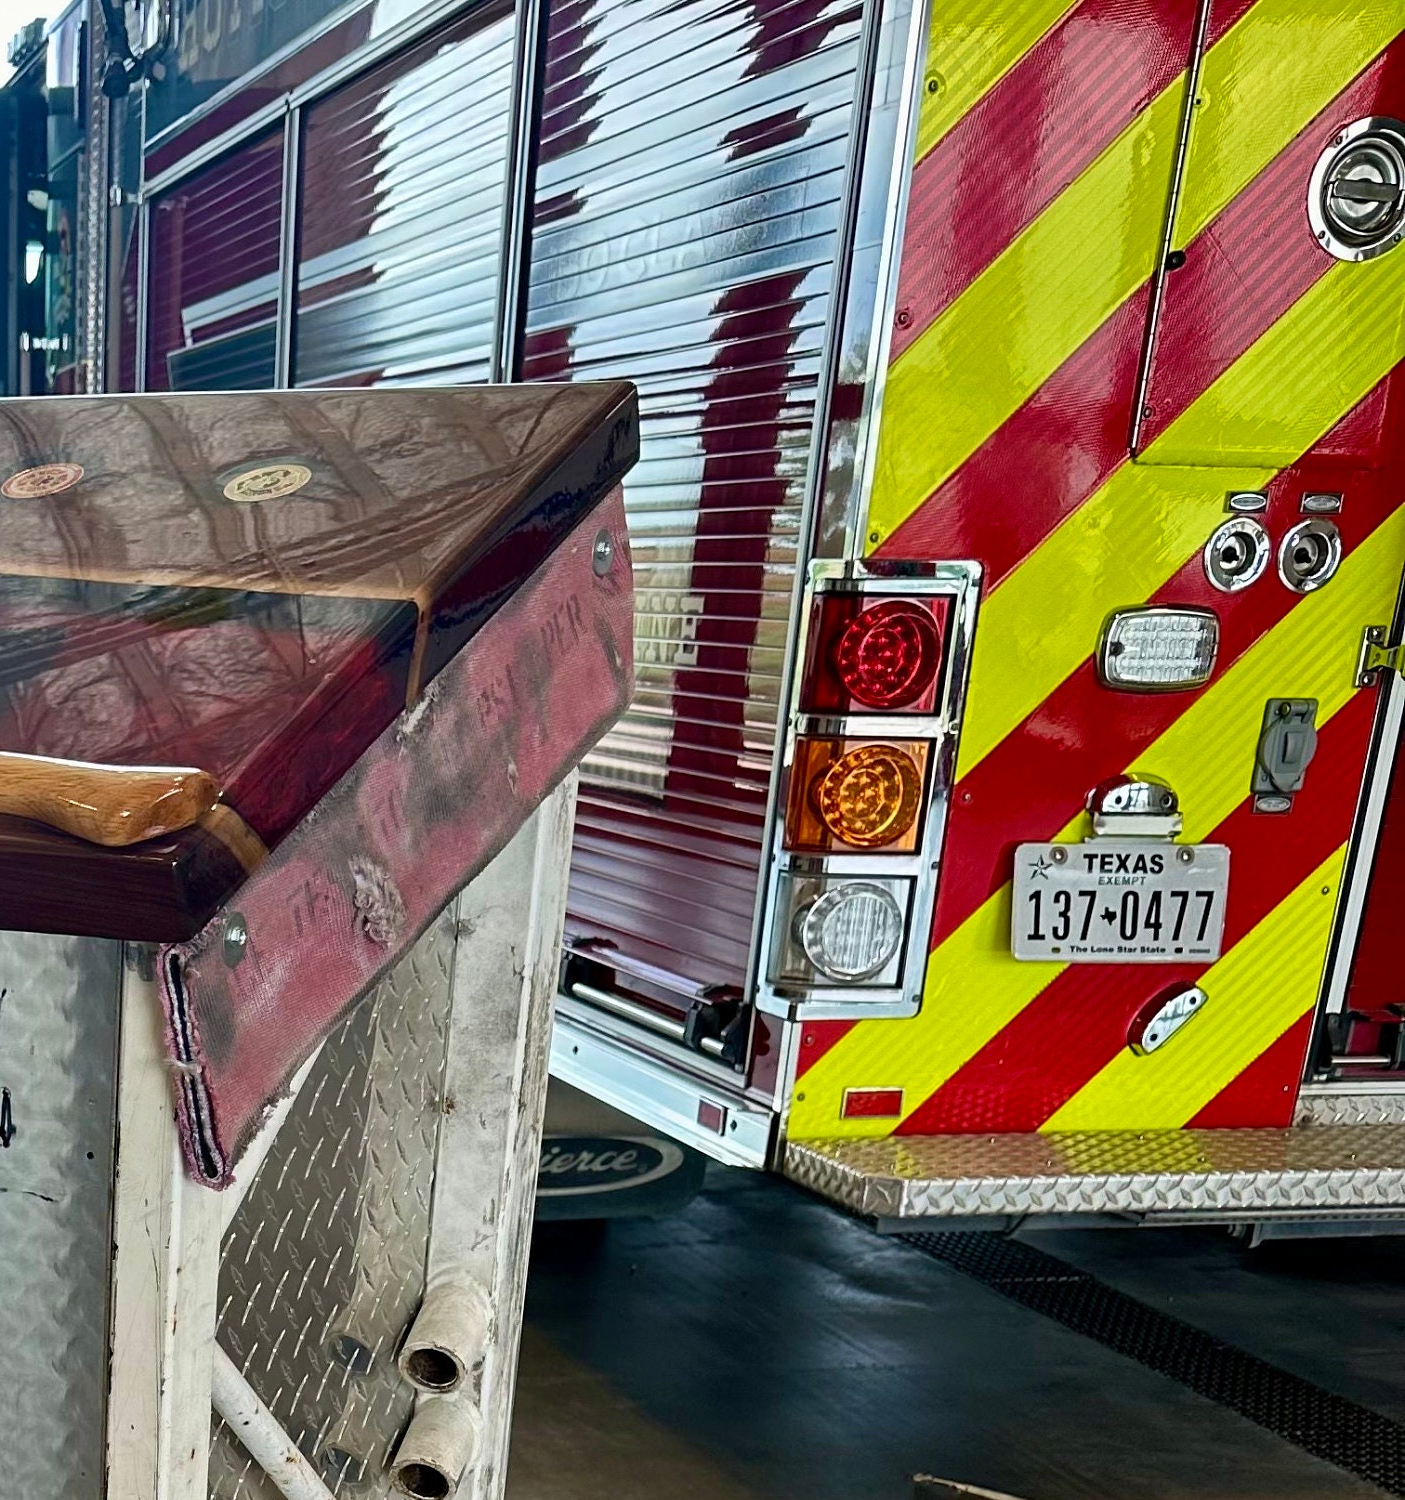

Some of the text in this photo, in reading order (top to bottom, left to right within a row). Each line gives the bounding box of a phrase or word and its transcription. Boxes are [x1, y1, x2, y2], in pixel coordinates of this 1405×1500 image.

[1083, 853, 1164, 874] TEXAS
[1098, 876, 1147, 886] EXEMPT
[1027, 889, 1215, 942] 137 0477
[1070, 945, 1166, 954] The Lone Star State
[539, 1146, 637, 1174] ierce
